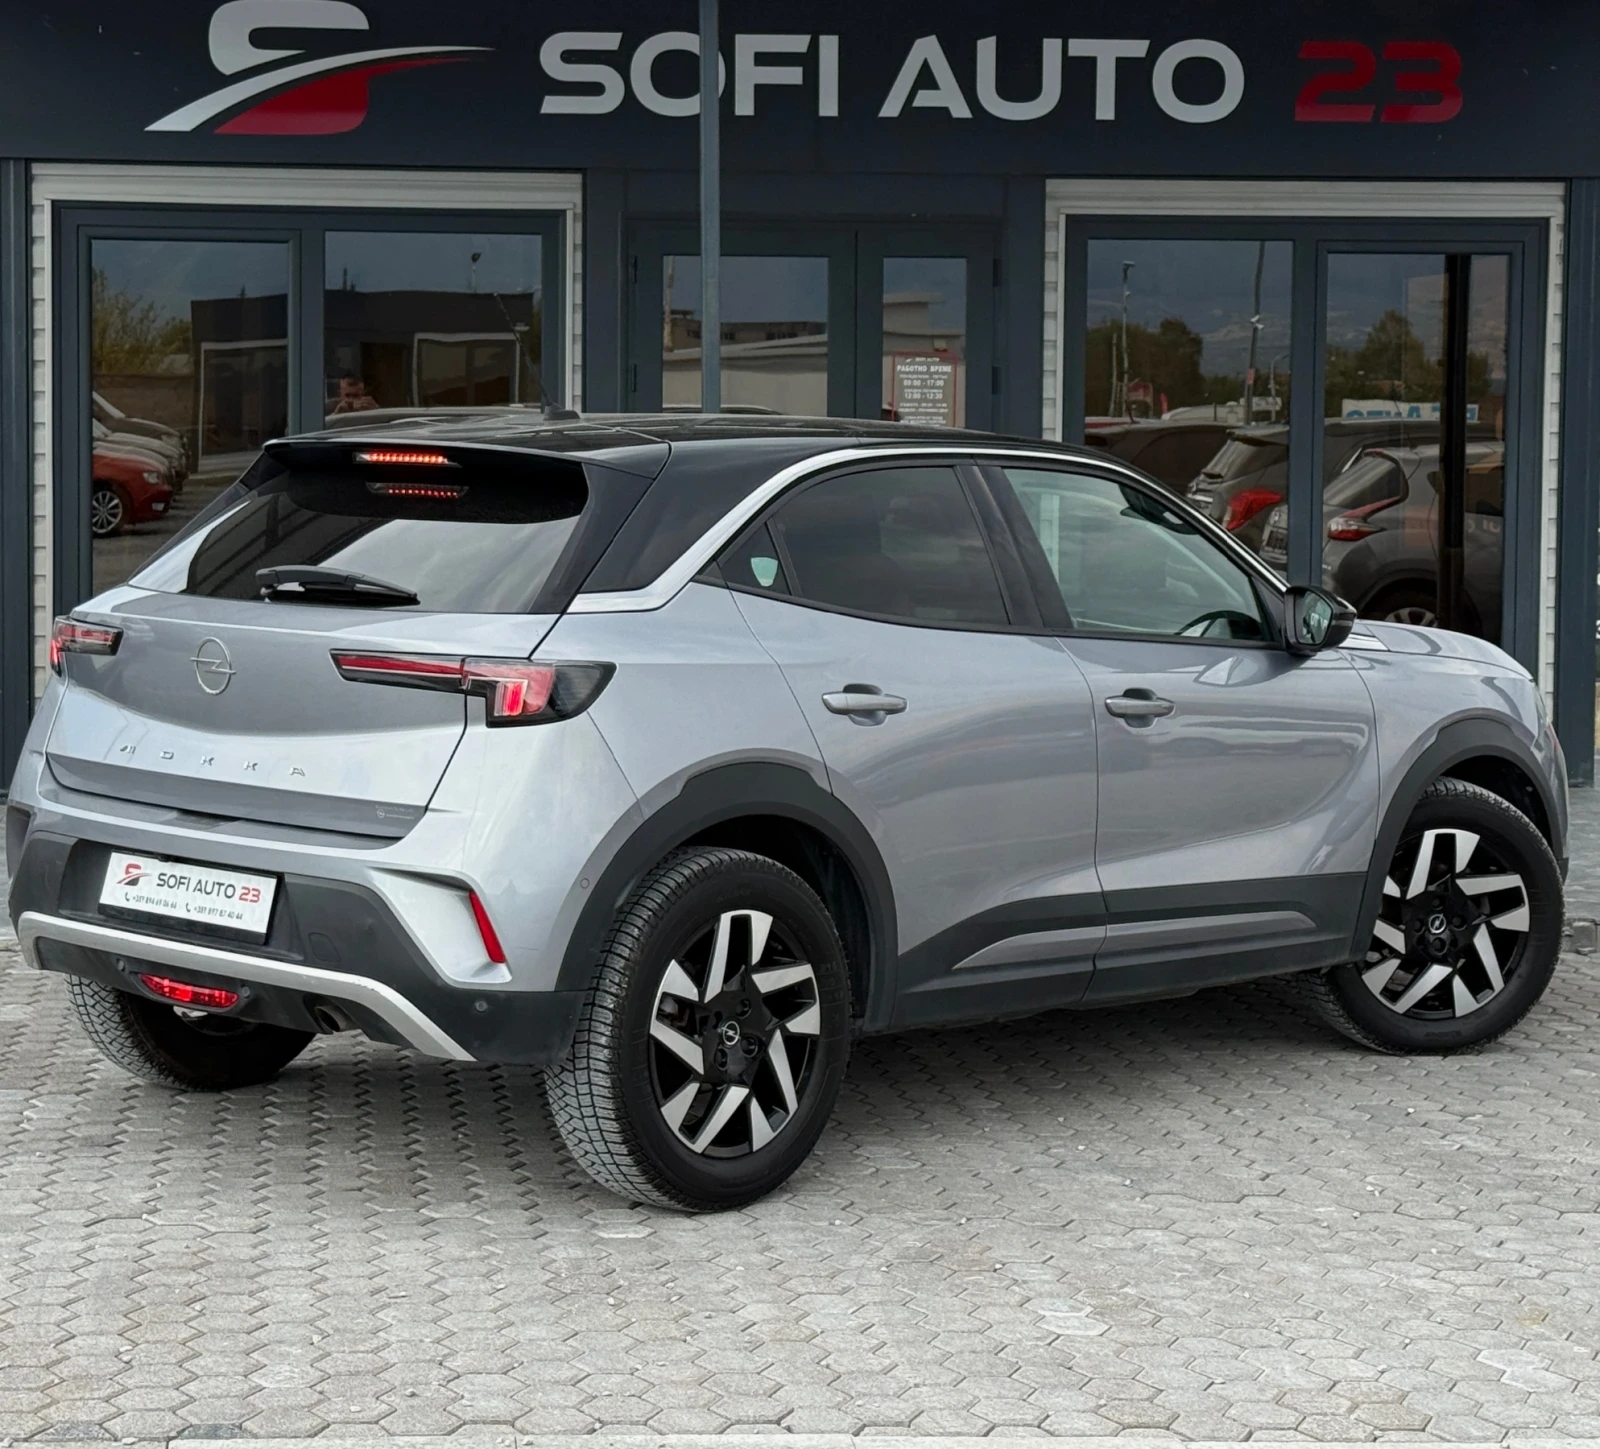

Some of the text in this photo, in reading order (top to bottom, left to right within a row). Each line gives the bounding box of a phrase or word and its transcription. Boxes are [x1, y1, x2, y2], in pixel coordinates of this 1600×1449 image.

[539, 31, 1464, 124] SOFI AUTO 23
[897, 364, 952, 373] РАБОТНО ВРЕМЕ
[903, 379, 922, 387] 09:00
[927, 379, 945, 387] 17:00
[156, 872, 262, 903] SOFI AUTO 23
